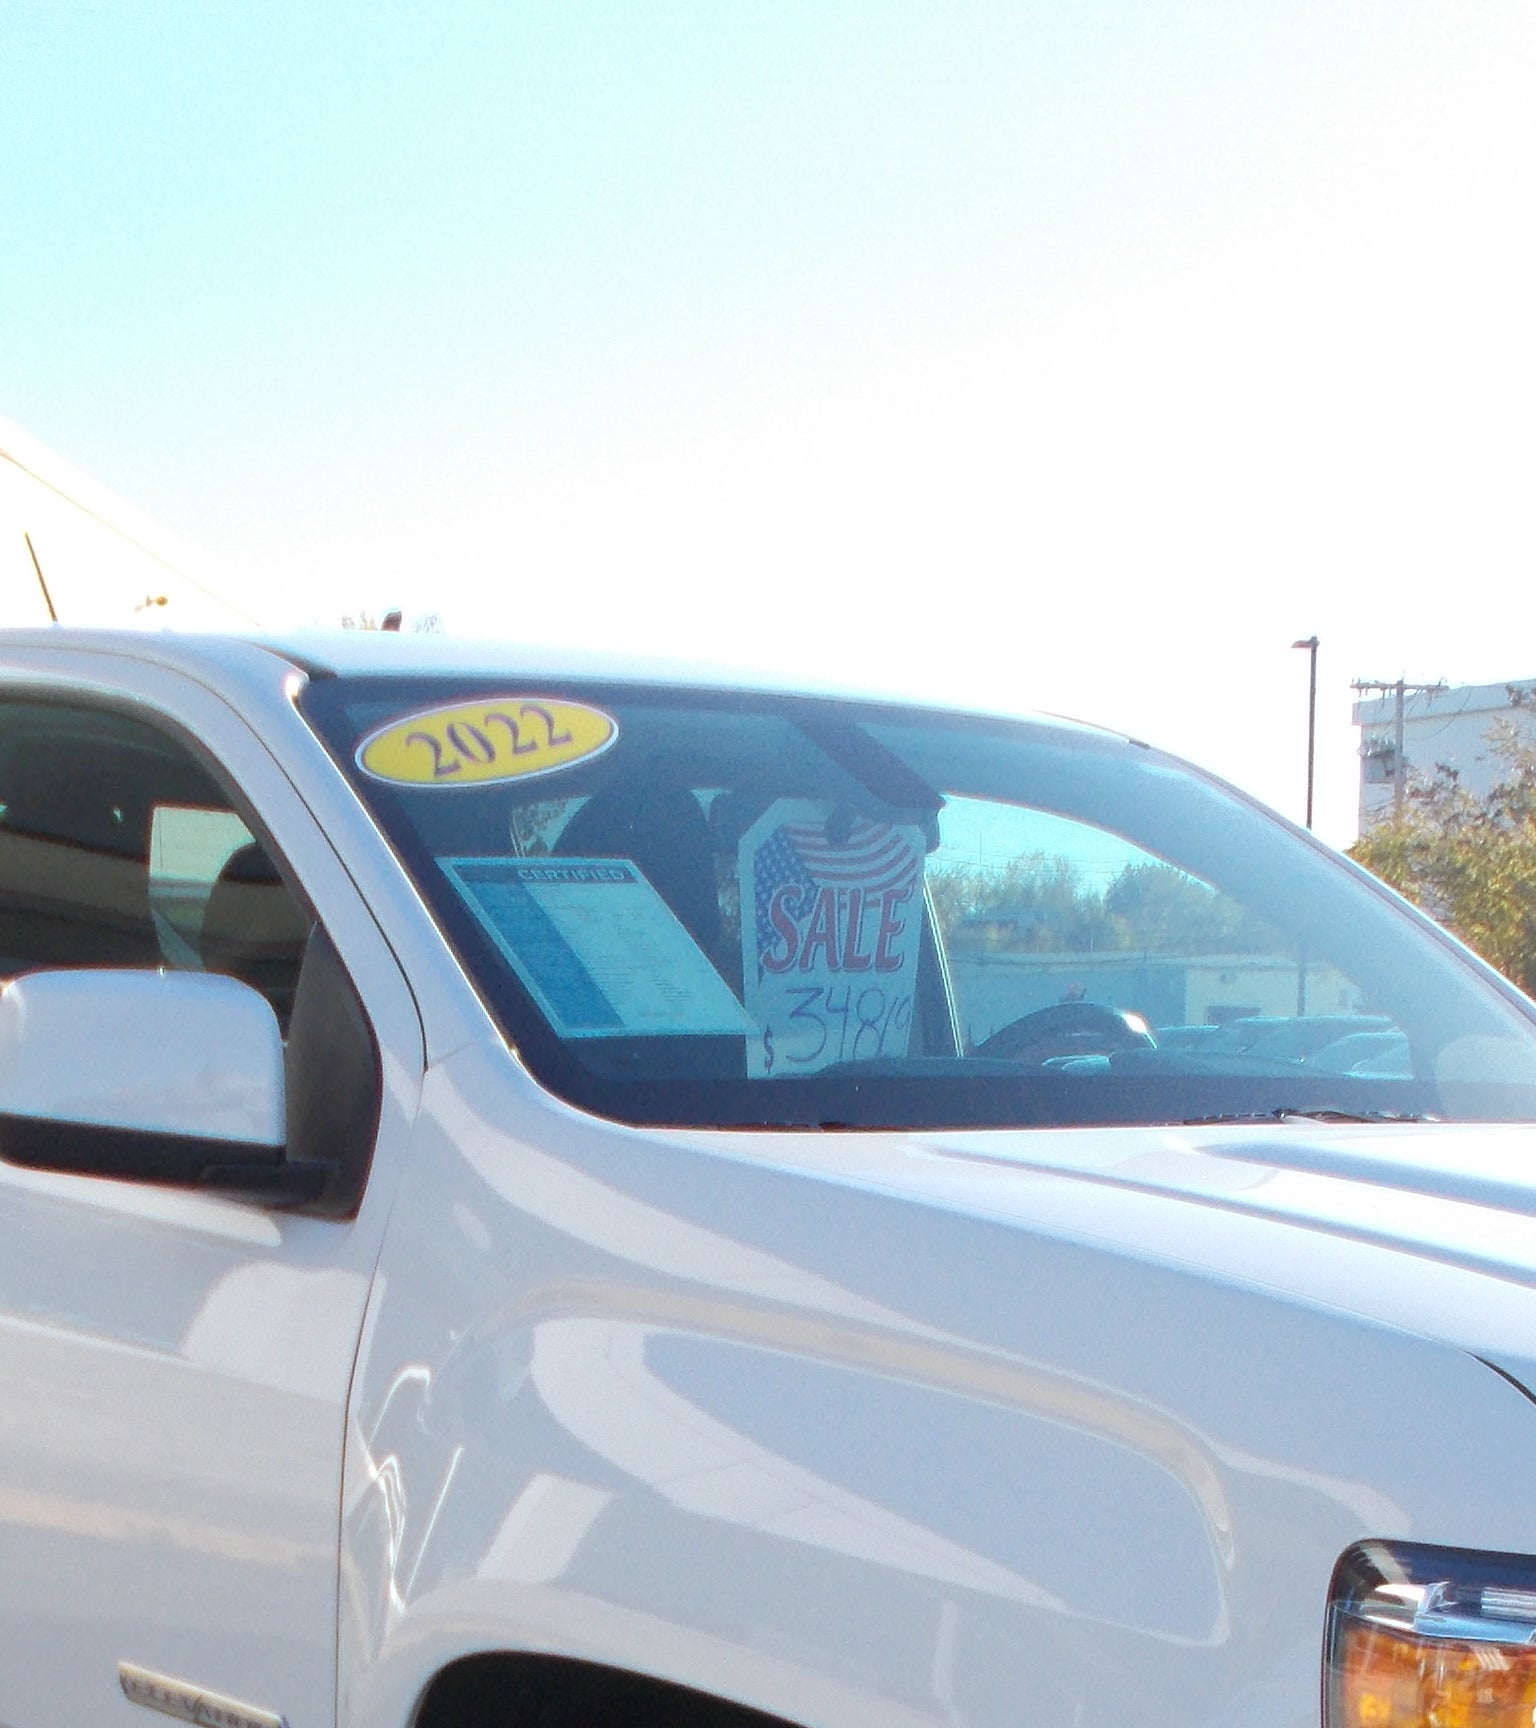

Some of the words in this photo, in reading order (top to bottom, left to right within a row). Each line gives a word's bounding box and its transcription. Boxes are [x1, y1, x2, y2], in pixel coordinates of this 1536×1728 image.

[404, 705, 572, 779] 2022
[517, 868, 625, 881] CERTIFIED
[760, 886, 909, 974] SALE
